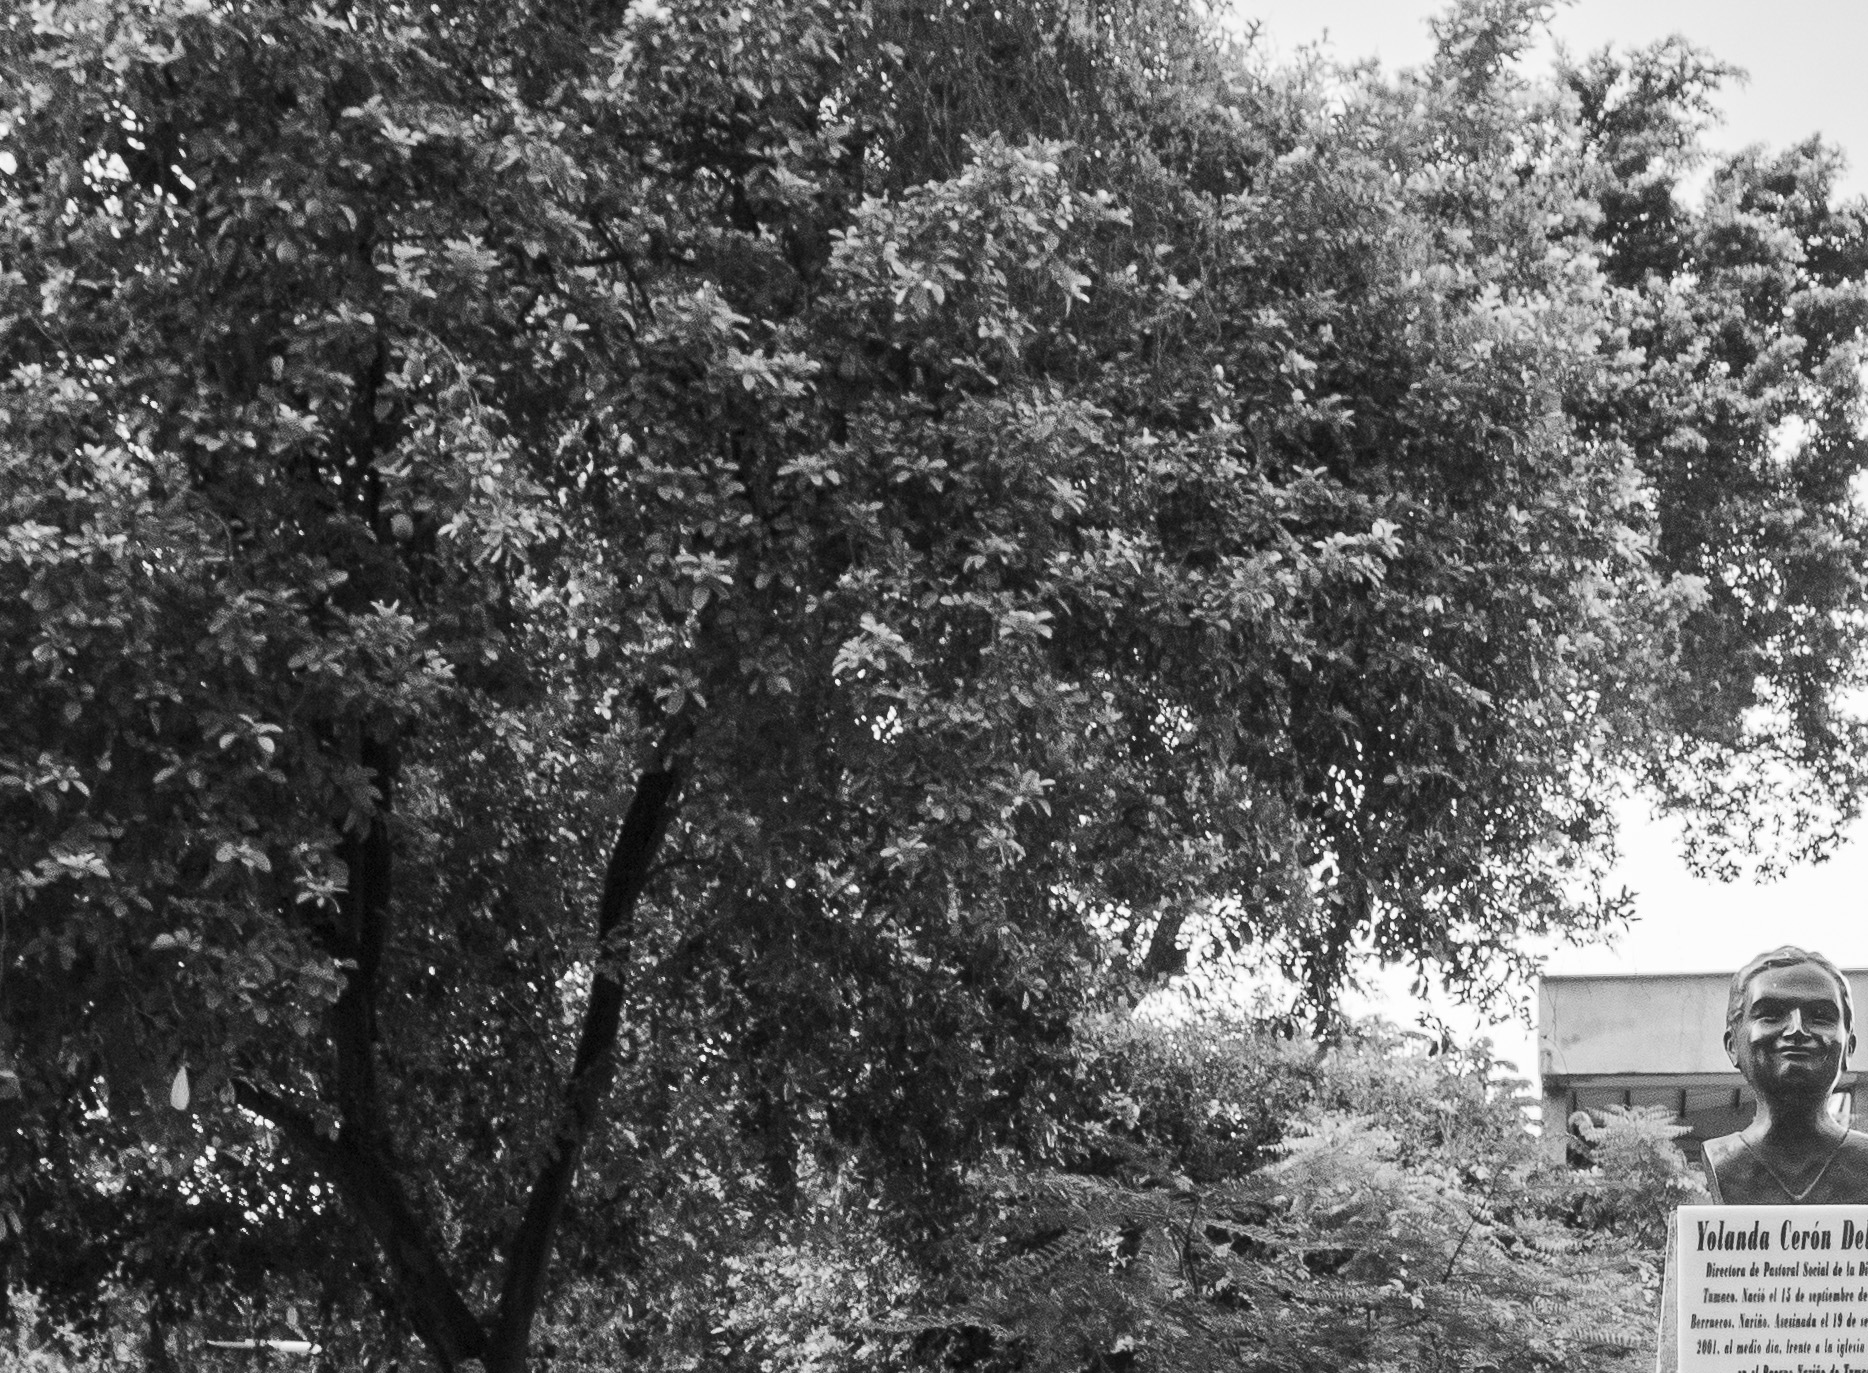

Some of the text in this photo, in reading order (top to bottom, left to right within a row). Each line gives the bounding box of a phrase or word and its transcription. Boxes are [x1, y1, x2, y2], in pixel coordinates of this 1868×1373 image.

[1697, 1220, 1770, 1251] Yolanda
[1780, 1219, 1831, 1251] Cerón
[1706, 1262, 1746, 1278] Directora
[1749, 1262, 1760, 1277] de
[1763, 1261, 1800, 1277] Pastoral
[1803, 1261, 1829, 1277] Social
[1832, 1261, 1843, 1277] de
[1846, 1261, 1855, 1277] la
[1769, 1287, 1777, 1302] el
[1795, 1287, 1805, 1302] de
[1809, 1287, 1854, 1307] septiembre
[1858, 1286, 1868, 1302] de
[1820, 1312, 1829, 1328] el
[1833, 1312, 1843, 1328] 19
[1846, 1312, 1856, 1328] de
[1724, 1339, 1733, 1354] al
[1736, 1339, 1761, 1354] medio
[1786, 1339, 1811, 1354] frente
[1815, 1344, 1820, 1353] a
[1824, 1338, 1833, 1353] la
[1837, 1338, 1865, 1358] iglesia
